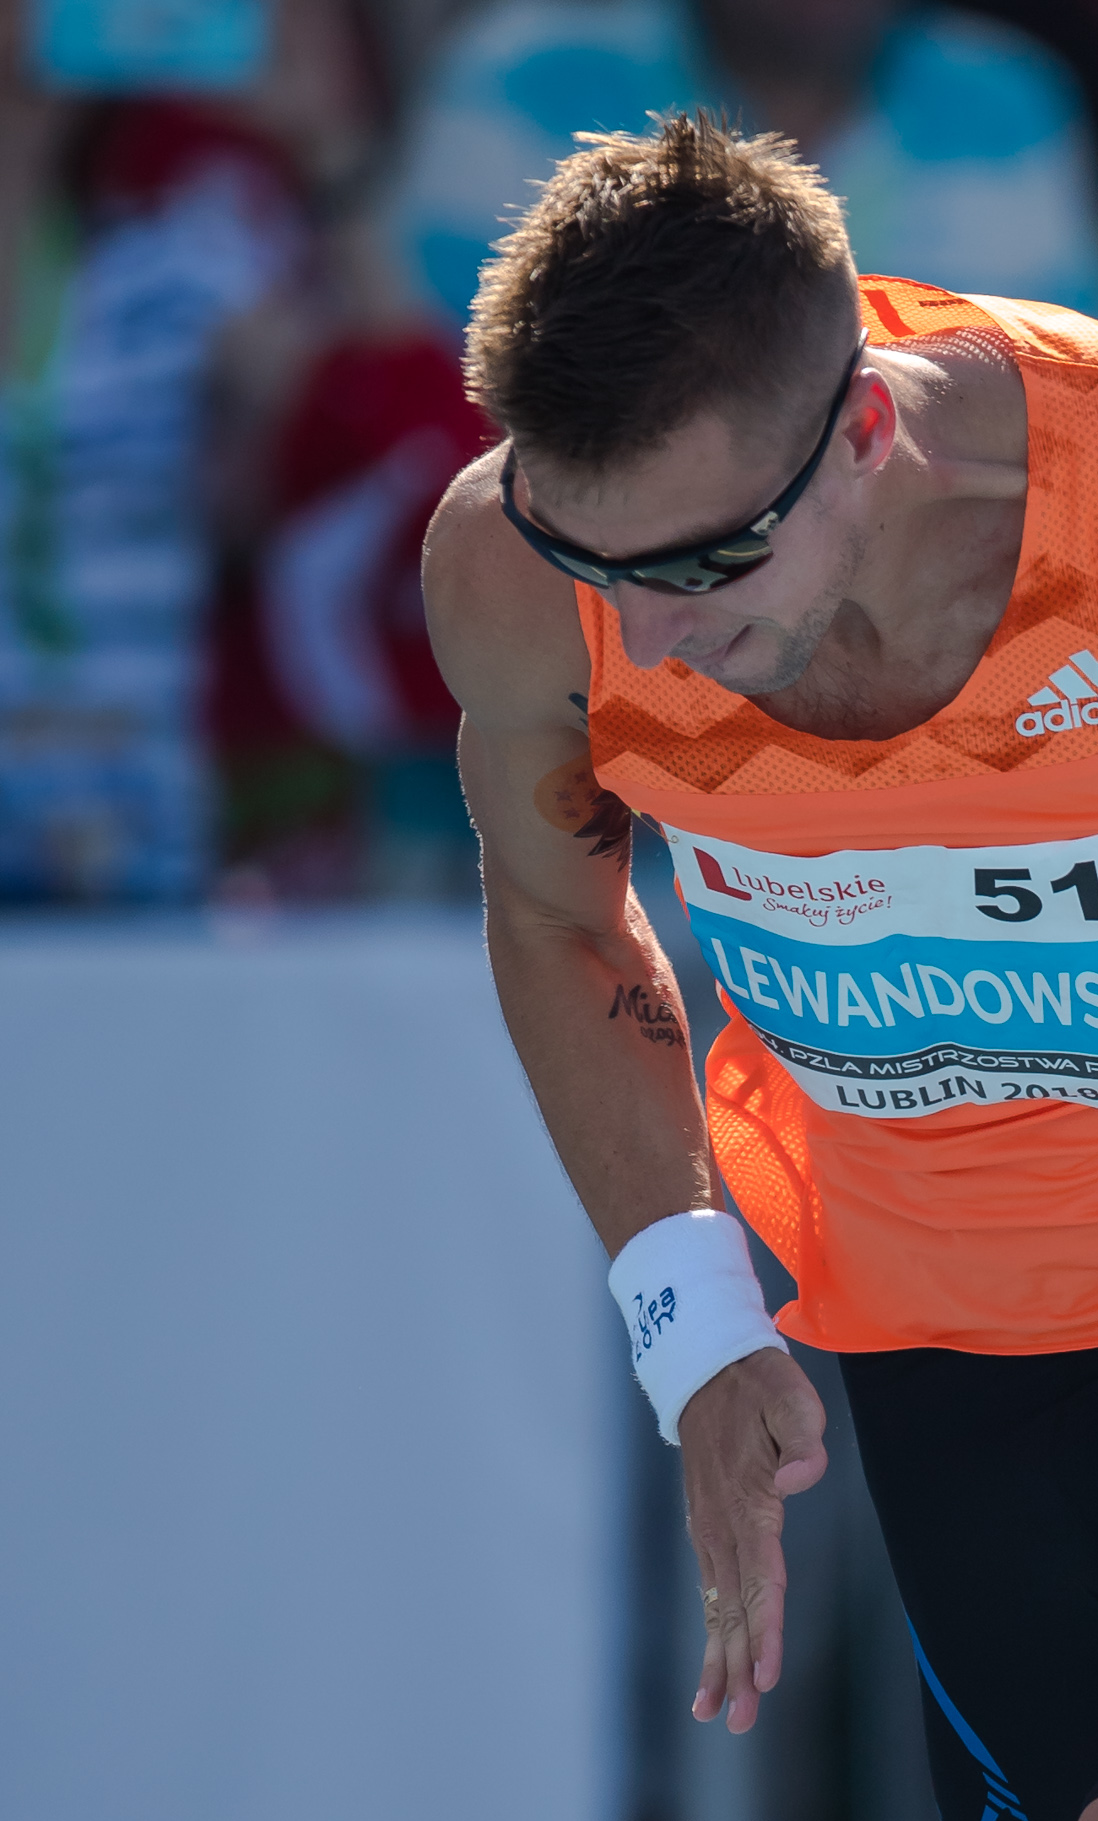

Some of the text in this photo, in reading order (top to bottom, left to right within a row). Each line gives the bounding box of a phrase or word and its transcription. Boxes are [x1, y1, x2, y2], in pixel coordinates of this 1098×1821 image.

[762, 898, 831, 927] Smakuj
[788, 1047, 863, 1074] PZLA
[869, 1048, 1081, 1075] MISTRZOSTWA
[836, 1075, 988, 1110] LUBLIN
